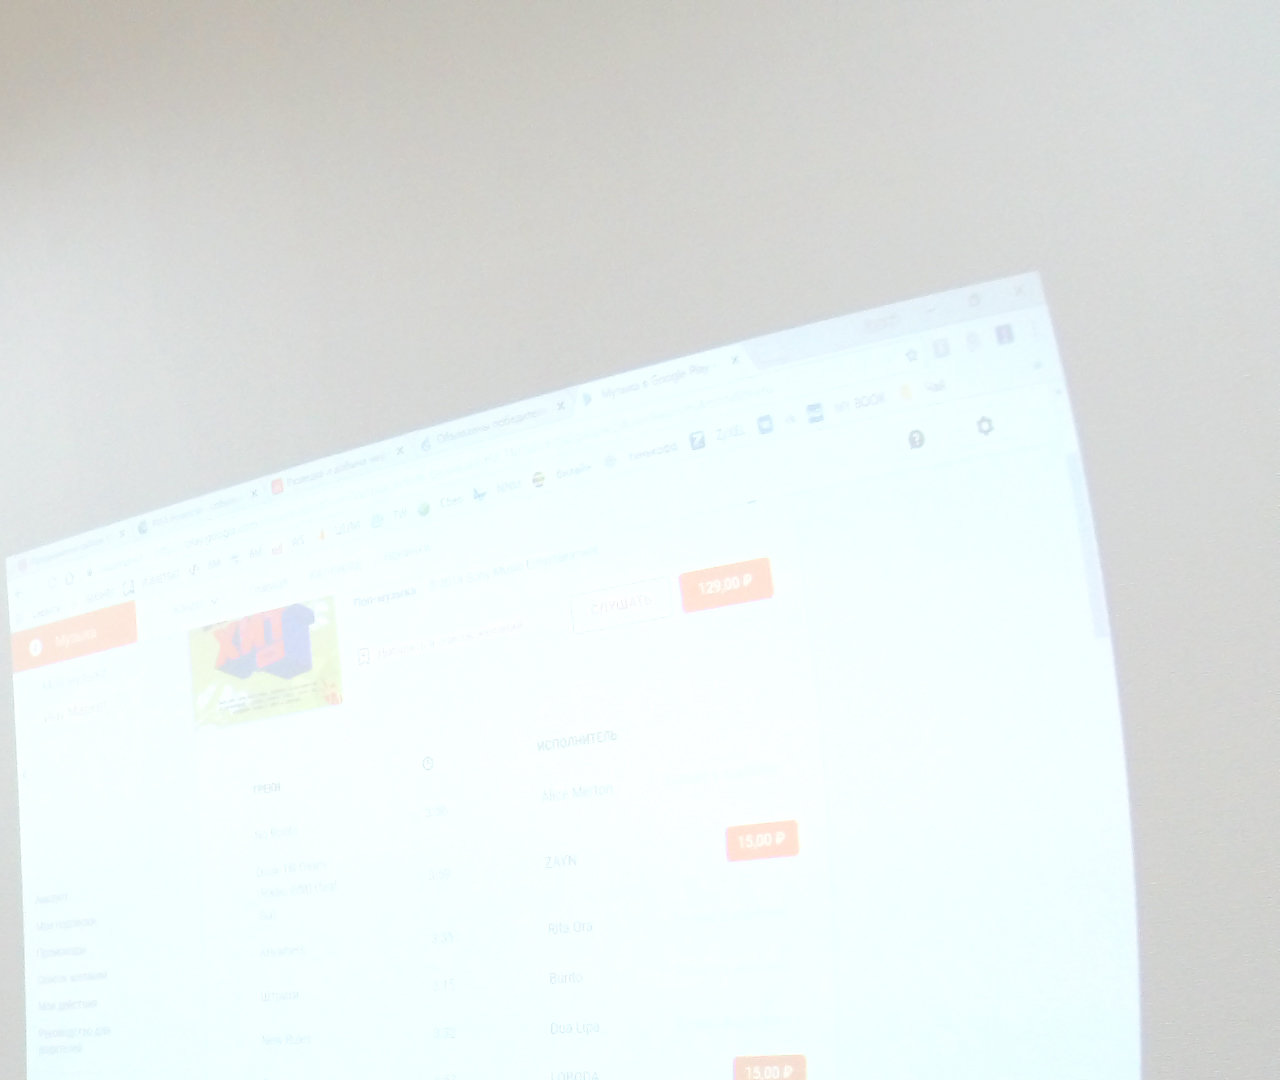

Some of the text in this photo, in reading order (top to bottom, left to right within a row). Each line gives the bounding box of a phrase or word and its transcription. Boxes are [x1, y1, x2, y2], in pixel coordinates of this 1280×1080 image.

[698, 576, 739, 596] 129,00
[536, 729, 618, 752] ИСПОЛНИТЕЛЬ
[738, 833, 773, 849] 15,00
[544, 854, 577, 869] ZAYN
[744, 1066, 779, 1080] 15,00
